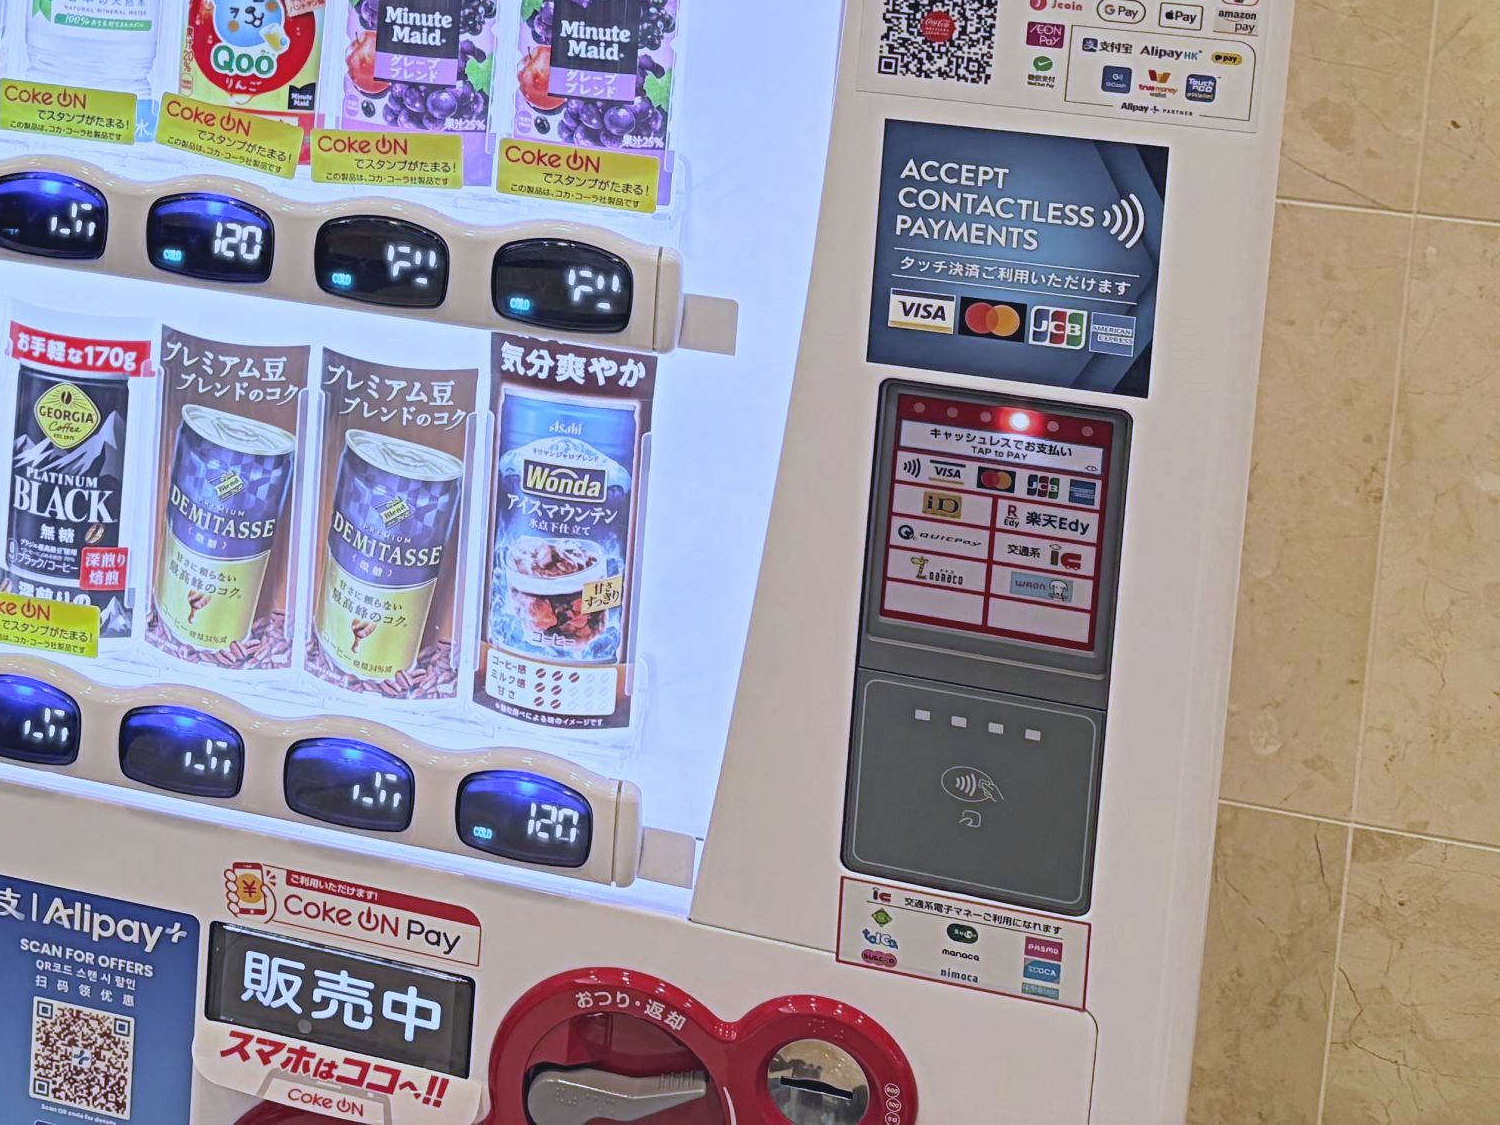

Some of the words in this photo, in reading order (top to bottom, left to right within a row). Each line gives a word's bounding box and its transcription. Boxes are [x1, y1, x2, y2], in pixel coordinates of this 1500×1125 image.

[385, 5, 453, 29] Minute
[392, 24, 446, 48] Maid
[1099, 41, 1132, 54] 支付宝
[210, 47, 274, 78] Qoo
[444, 116, 486, 132] 果汁25%
[317, 136, 371, 155] Coke
[355, 155, 456, 174] でスタンプがたまる!
[900, 159, 1009, 189] ACCEPT
[898, 187, 1095, 228] CONTACTLESS
[212, 223, 262, 261] 120
[896, 214, 1038, 251] PAYMENTS
[900, 256, 1131, 297] タッチ決済ご利用いただけます
[898, 300, 946, 322] VISA
[1033, 319, 1081, 336] JCB
[18, 332, 137, 370] お手軽な170g
[165, 341, 288, 381] プレミアム豆
[501, 341, 646, 388] 気分爽やか
[176, 372, 298, 405] ブレンドのコク
[930, 428, 1072, 457] キャッシュレスでお支払い
[972, 445, 992, 456] TAP
[994, 449, 1005, 458] to
[1007, 451, 1028, 461] PAY
[26, 466, 98, 488] PLATINUM
[526, 464, 602, 498] Wonda
[14, 475, 117, 524] BLACK
[508, 492, 618, 525] アイスマウンテン
[40, 522, 75, 543] 無糖
[1026, 511, 1090, 536] 楽天Edy
[333, 513, 443, 567] DEMITASSE
[1007, 544, 1040, 559] 交通系
[85, 552, 126, 570] 深煎り
[89, 568, 120, 586] 焙煎
[2, 618, 93, 643] でスタンプがたまる!
[526, 802, 580, 843] 120
[284, 895, 353, 924] Coke
[358, 906, 399, 938] ON
[406, 921, 461, 954] Pay
[904, 896, 1063, 936] 交通系電子マネーご利用になれます
[20, 938, 57, 959] SCAN
[60, 947, 95, 965] FOR
[98, 956, 154, 978] OFFERS
[35, 959, 73, 977] QR코드
[76, 965, 98, 981] 스캔
[101, 972, 112, 985] 시
[114, 975, 136, 991] 할인
[241, 951, 443, 1043] 販売中
[575, 990, 687, 1032] おつり・返却
[220, 1030, 449, 1109] スマホはココへ!!
